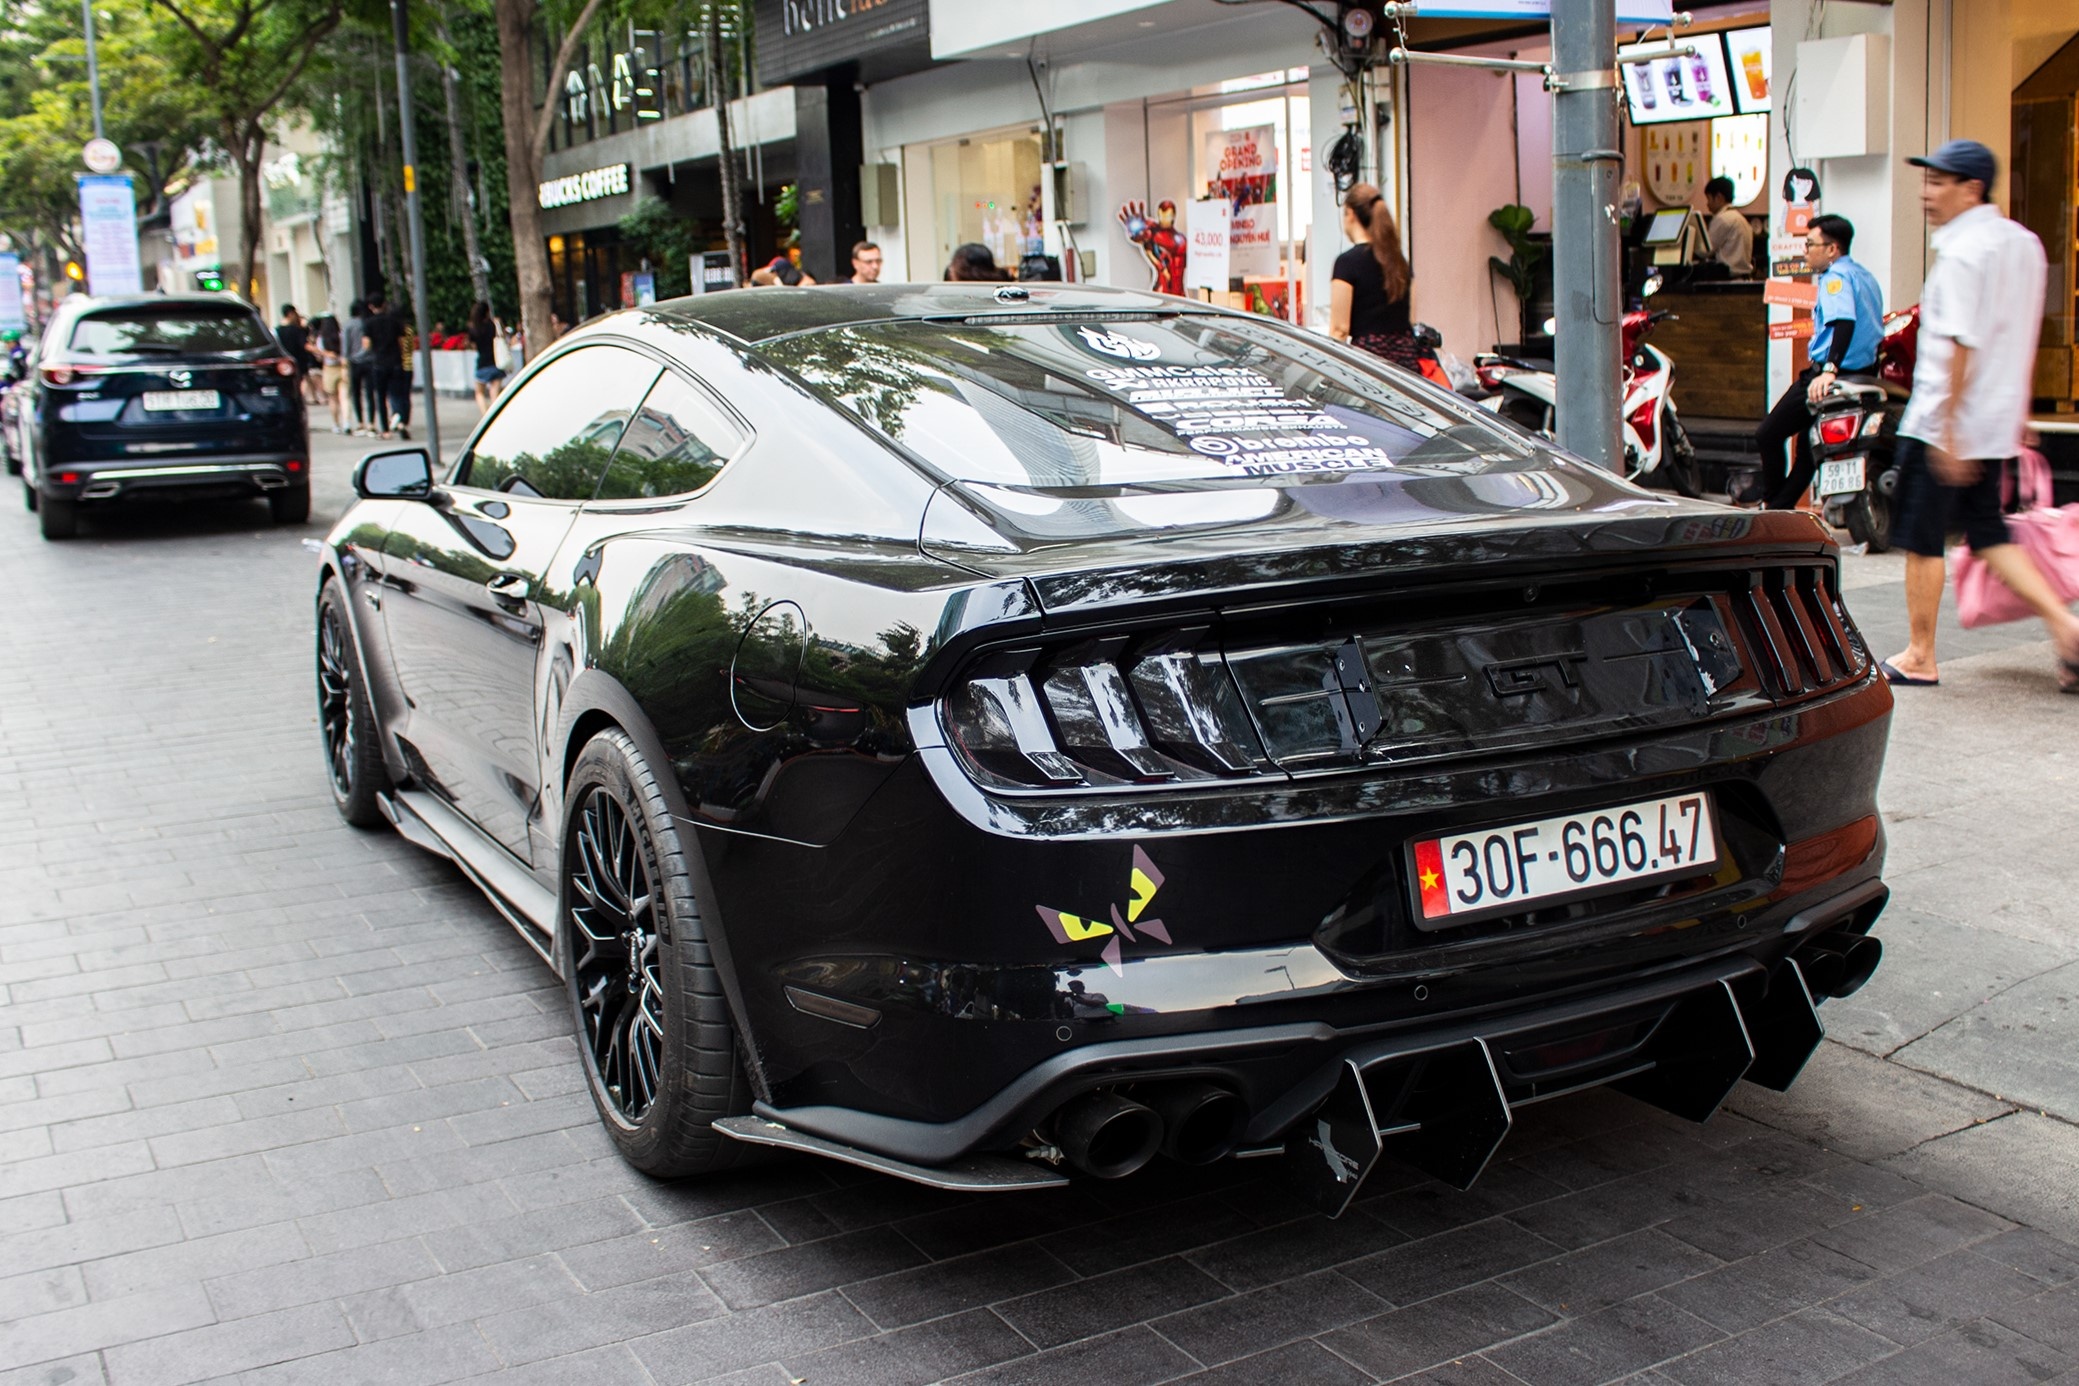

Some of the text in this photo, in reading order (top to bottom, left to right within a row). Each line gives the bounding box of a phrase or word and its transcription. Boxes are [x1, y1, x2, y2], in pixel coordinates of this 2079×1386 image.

[1224, 143, 1257, 158] GRAND
[1220, 154, 1262, 171] OPENING
[581, 163, 629, 200] COFFEE
[1175, 415, 1342, 430] CORSA
[1232, 433, 1370, 451] brembo
[1225, 448, 1388, 466] AMERICAN
[1243, 458, 1387, 476] MUSCLE
[1482, 651, 1588, 699] GT
[1451, 797, 1700, 905] 30F-666.47
[629, 798, 670, 938] MICHELIN
